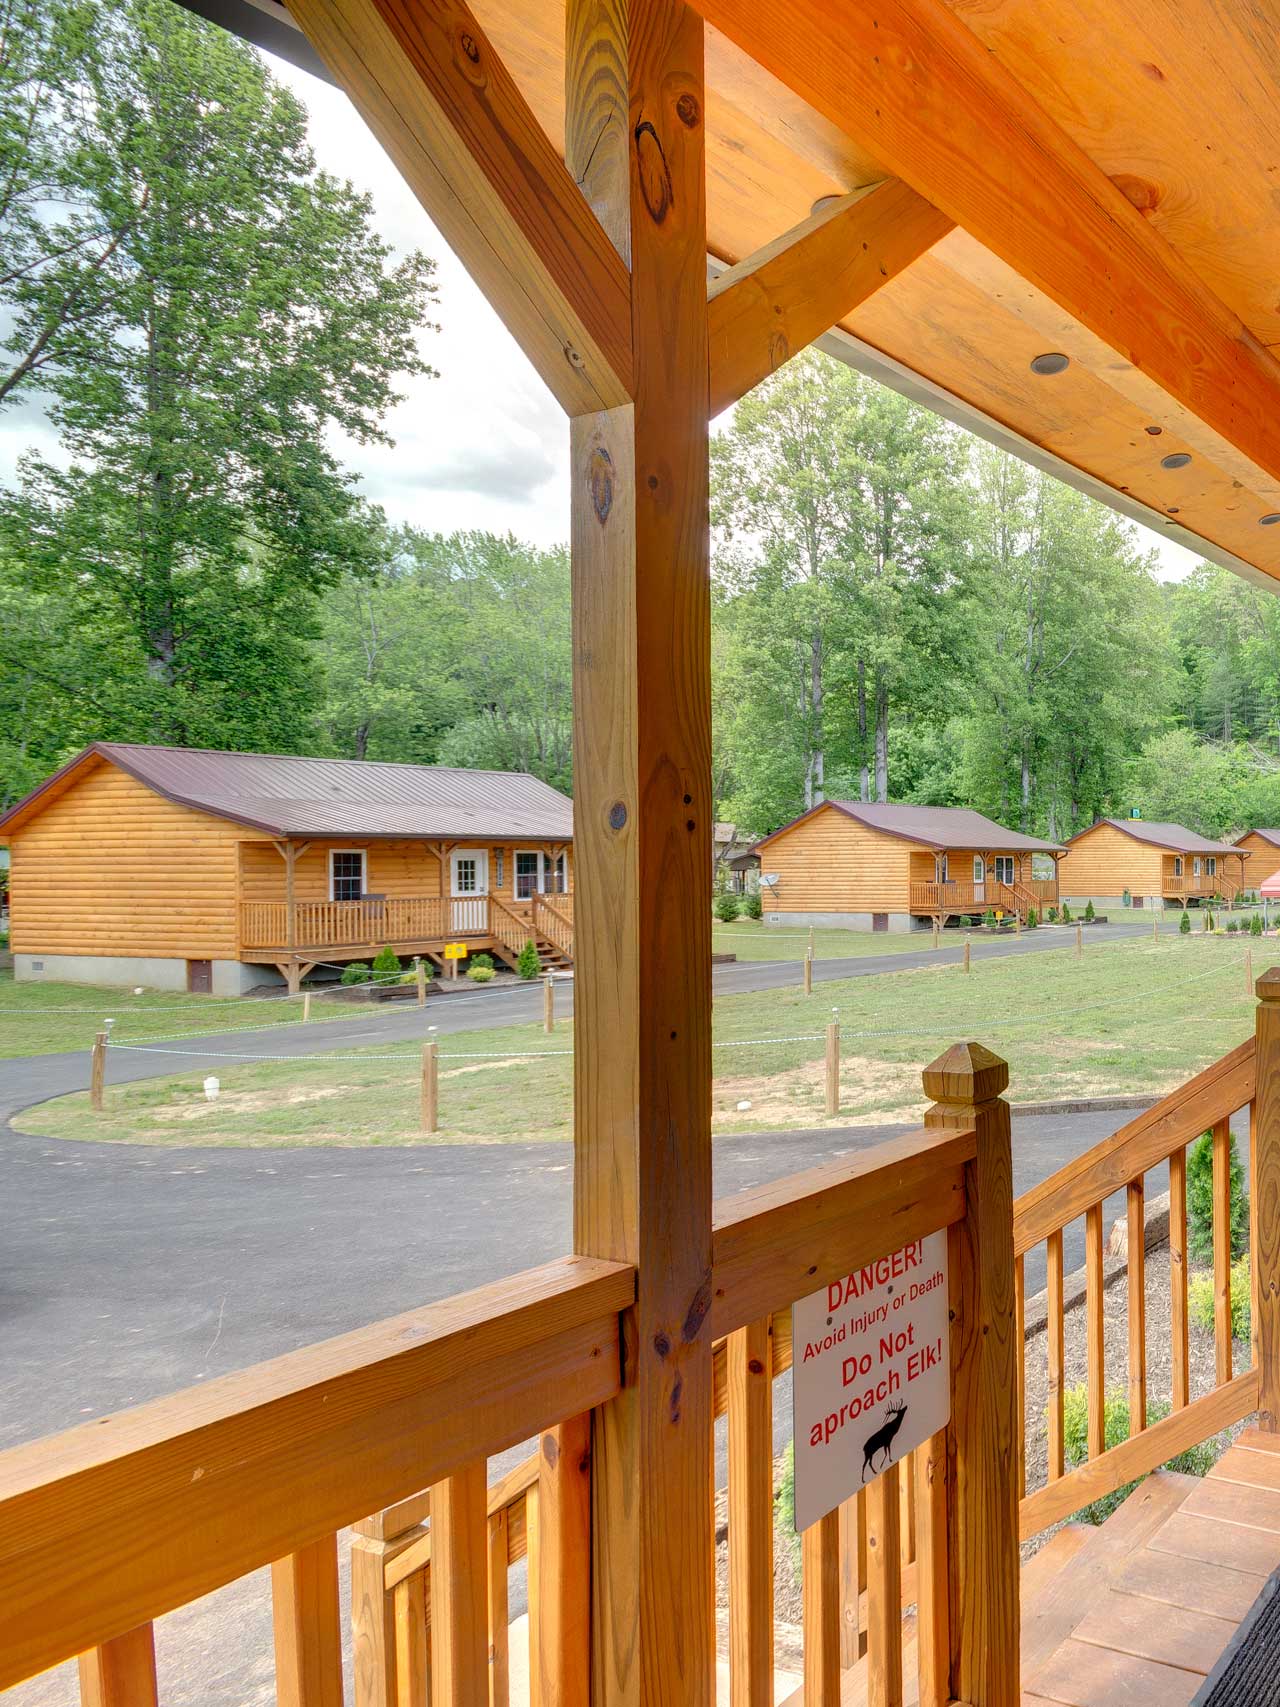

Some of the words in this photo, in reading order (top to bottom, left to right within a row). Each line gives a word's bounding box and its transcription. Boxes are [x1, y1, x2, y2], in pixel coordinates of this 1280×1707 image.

[803, 1323, 846, 1363] Avoid
[850, 1303, 889, 1335] Injury
[892, 1293, 906, 1311] or
[909, 1270, 944, 1302] Death
[827, 1239, 923, 1313] DANGER!
[810, 1369, 900, 1447] aproach
[907, 1337, 942, 1382] Elk!
[842, 1353, 872, 1388] Do
[879, 1321, 914, 1364] Not
